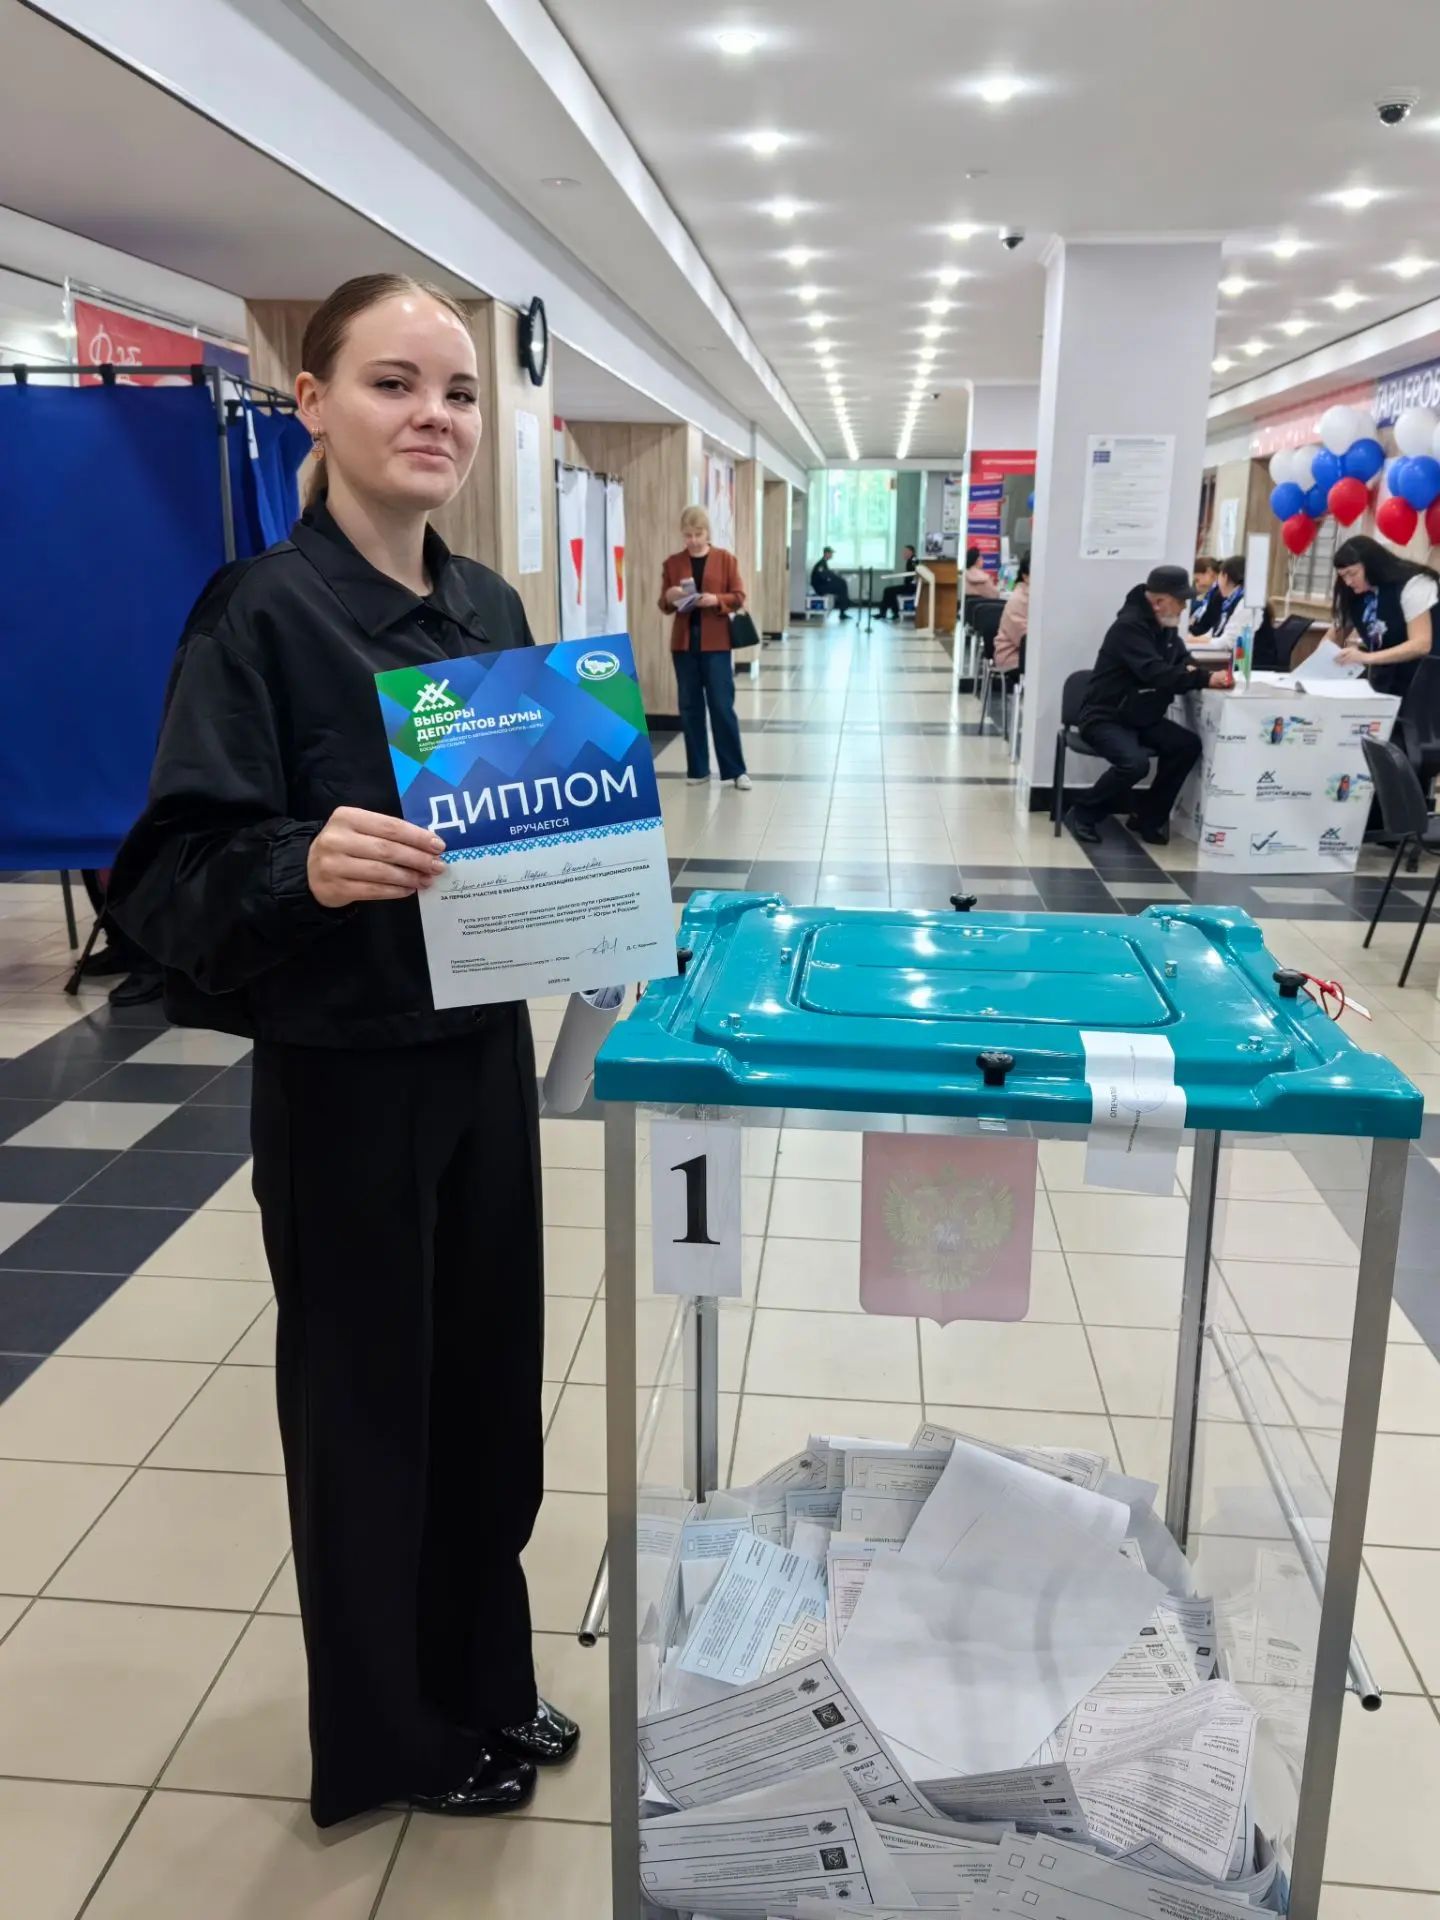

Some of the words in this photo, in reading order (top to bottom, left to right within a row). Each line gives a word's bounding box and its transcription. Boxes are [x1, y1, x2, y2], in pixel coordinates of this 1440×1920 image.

[414, 708, 475, 727] ВЫБОРЫ
[416, 718, 496, 742] ДЕПУТАТОВ
[498, 709, 542, 728] ДУМЫ
[427, 765, 638, 834] ДИПЛОМ
[510, 817, 570, 835] ВРУЧАЕТСЯ
[448, 891, 471, 900] ПЕРВОЕ
[472, 889, 498, 897] УЧАСТИЕ
[502, 884, 529, 893] ВЫБОРАХ
[534, 876, 573, 888] РЕАЛИЗАЦИЮ
[574, 866, 632, 881] КОНСТИТУЦИОННОГО
[671, 1154, 721, 1245] 1
